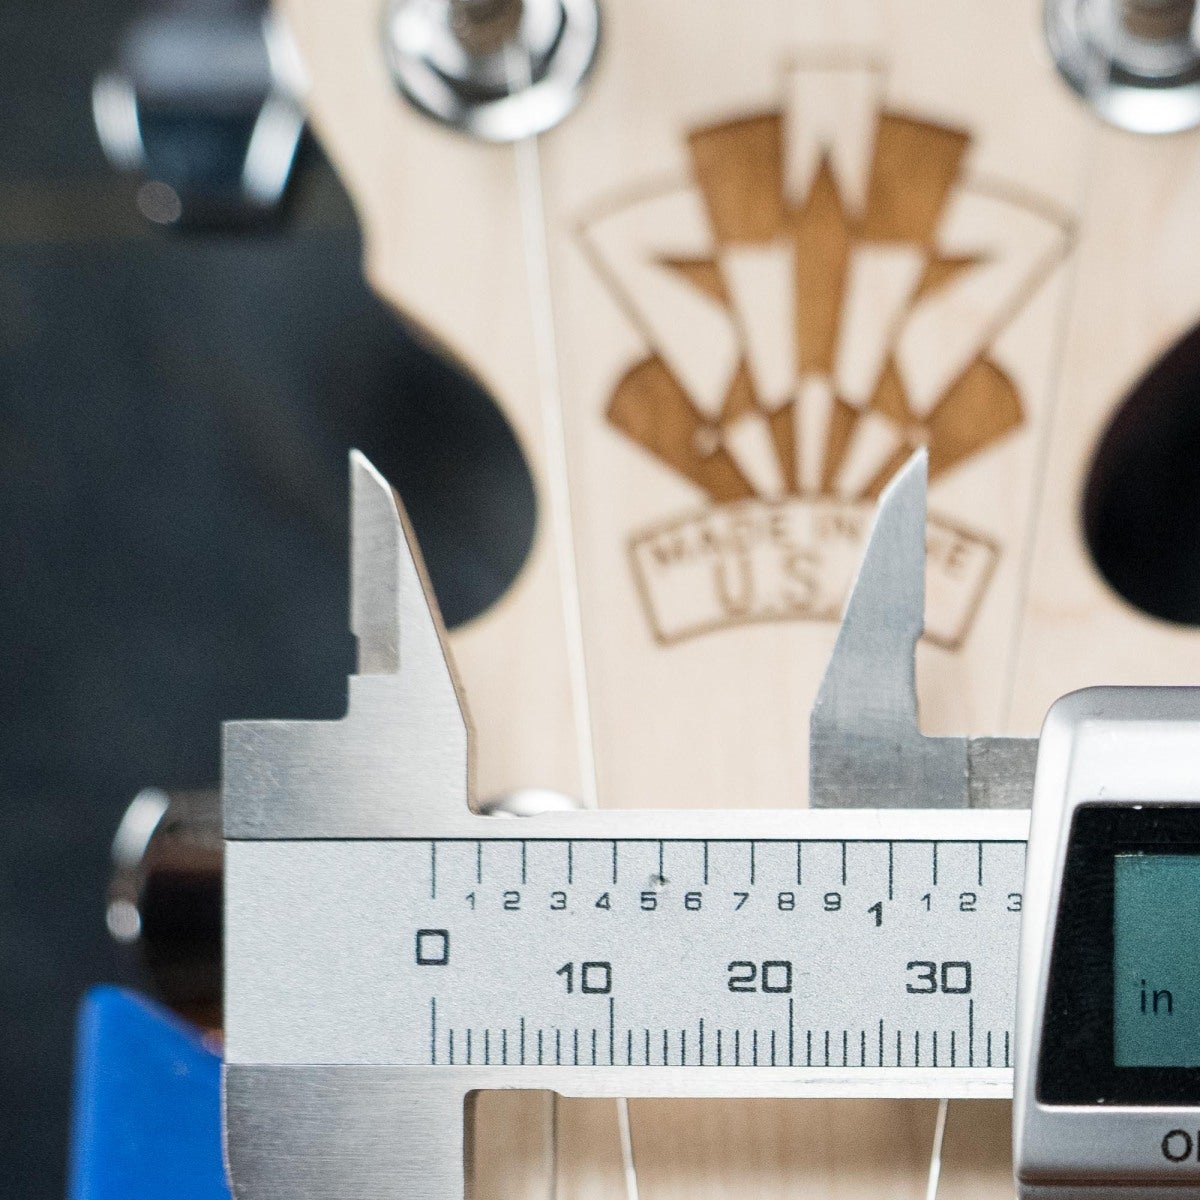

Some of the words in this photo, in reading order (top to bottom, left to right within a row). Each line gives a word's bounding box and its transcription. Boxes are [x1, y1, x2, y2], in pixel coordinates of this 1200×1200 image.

[466, 892, 475, 911] 1
[503, 892, 521, 911] 2
[550, 892, 567, 911] 3
[594, 892, 611, 911] 4
[641, 892, 658, 911] 5
[685, 892, 703, 911] 6
[733, 892, 750, 911] 7
[777, 892, 796, 911] 8
[824, 892, 842, 911] 9
[867, 901, 883, 927] 1
[921, 893, 931, 911] 1
[959, 892, 977, 911] 2
[1007, 893, 1022, 912] 3
[415, 929, 450, 966] 0
[556, 961, 613, 995] 10
[727, 961, 793, 994] 20
[905, 961, 972, 995] 30
[1140, 979, 1174, 1016] in
